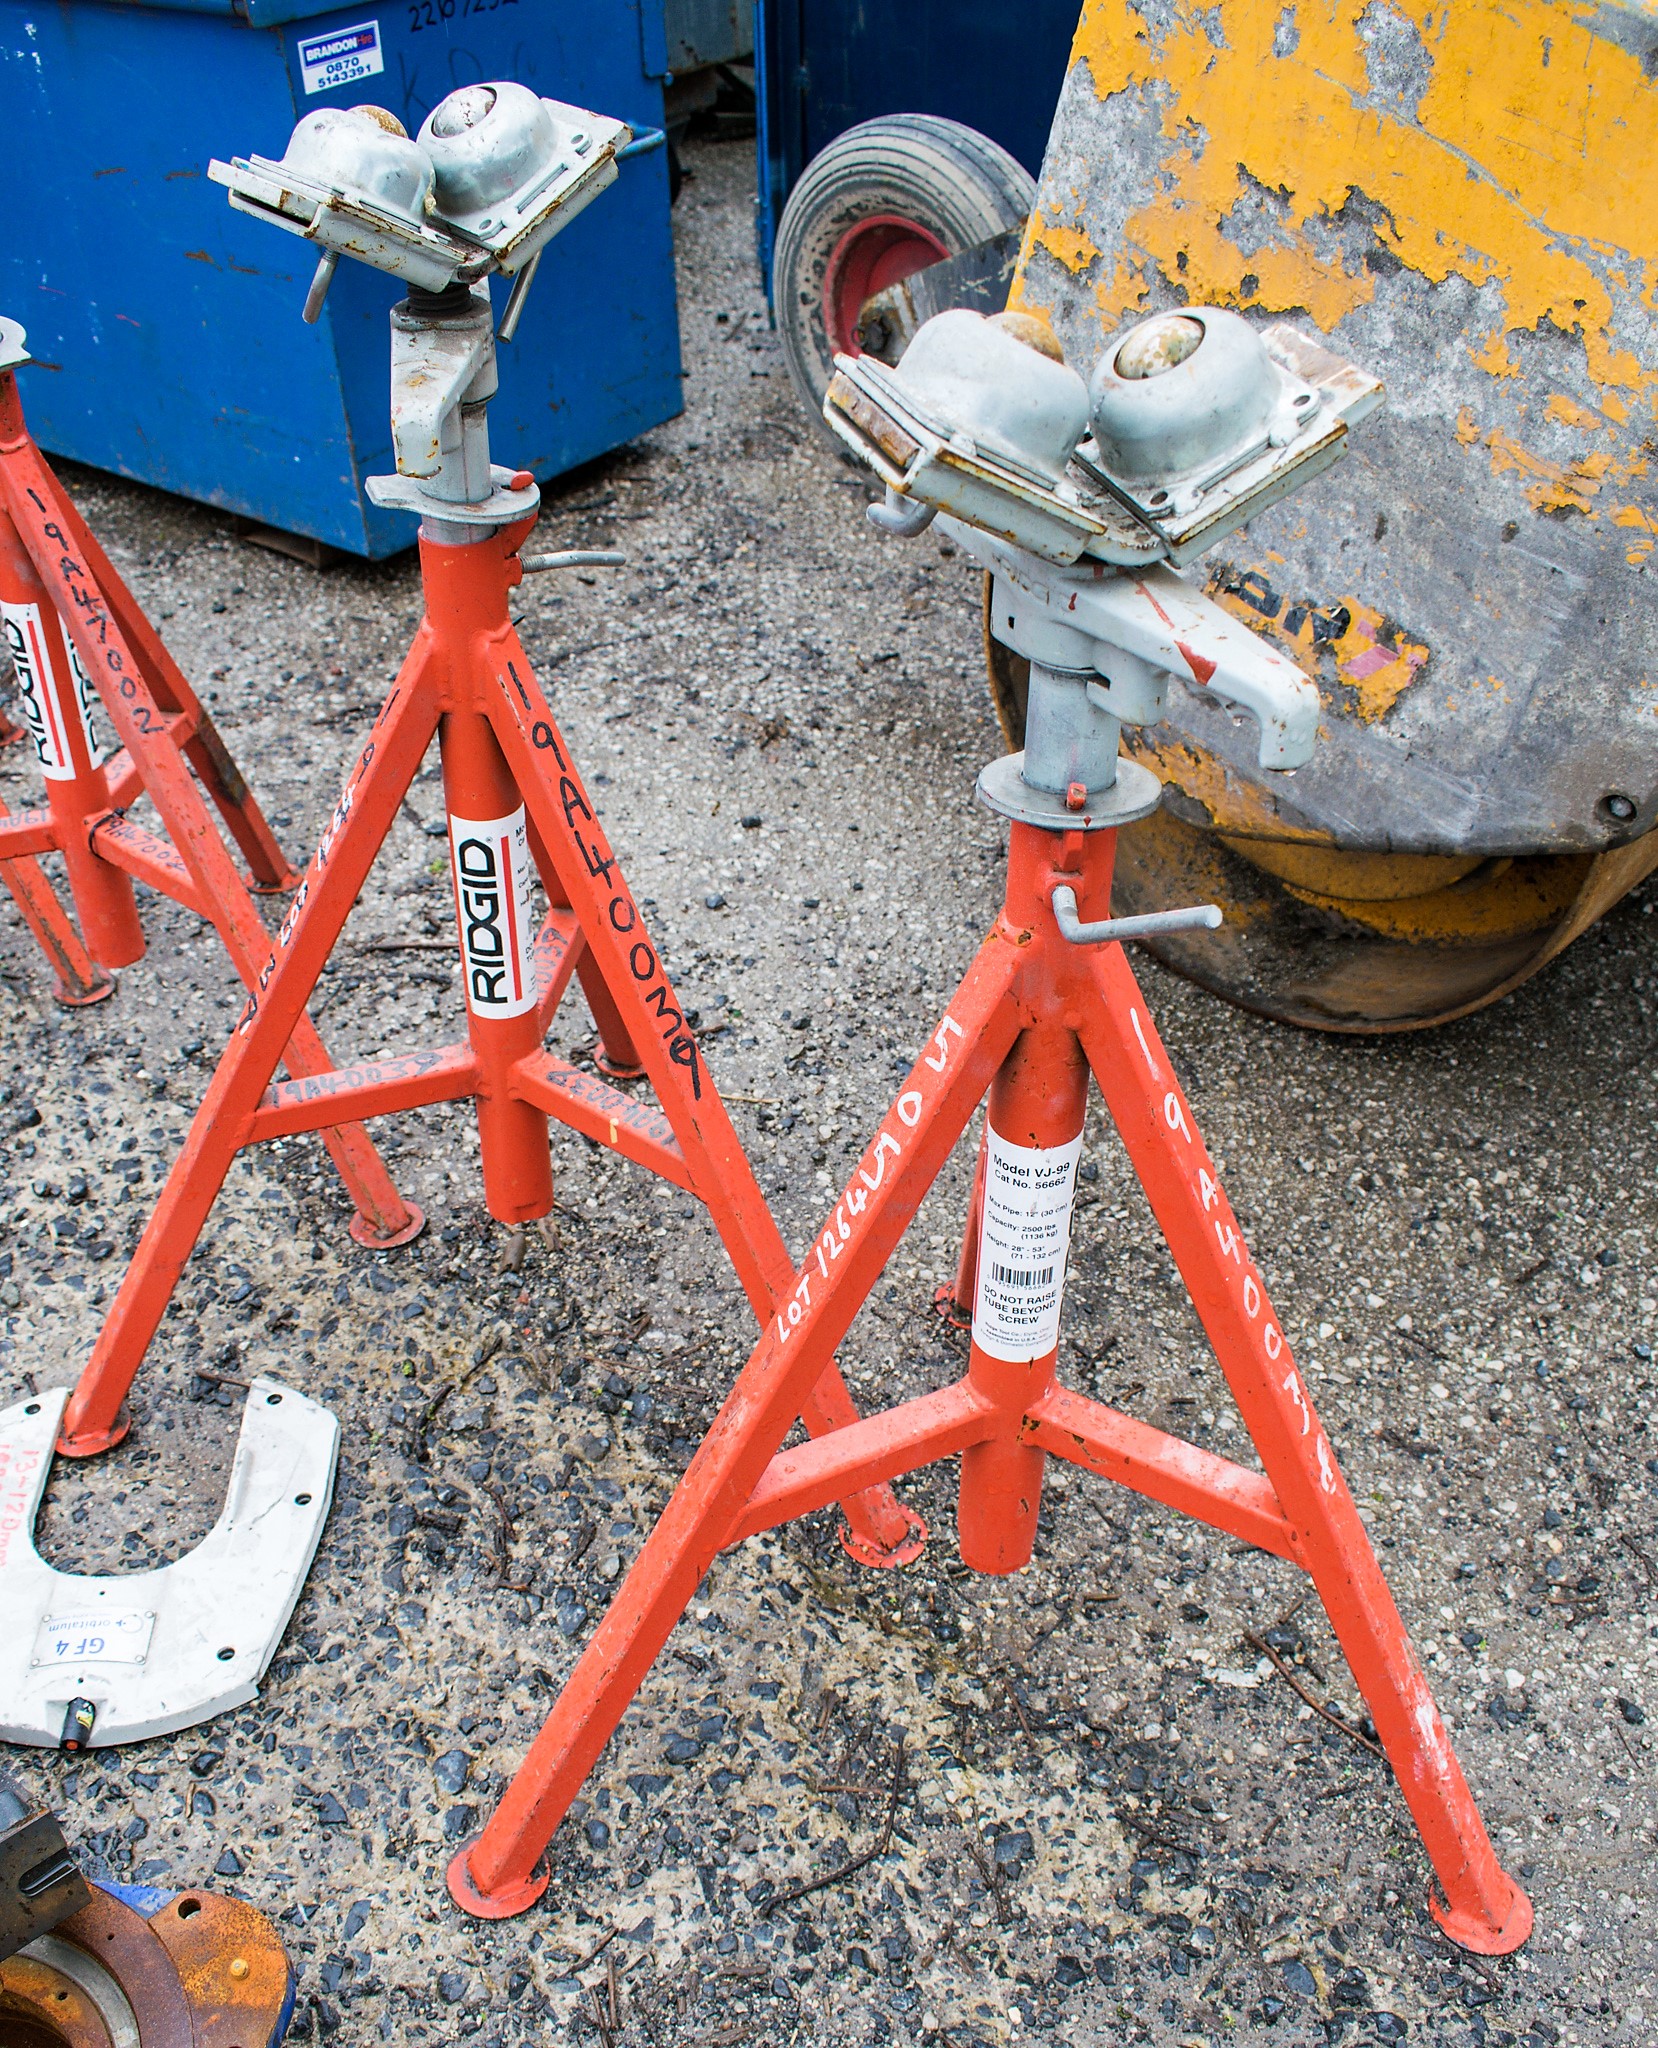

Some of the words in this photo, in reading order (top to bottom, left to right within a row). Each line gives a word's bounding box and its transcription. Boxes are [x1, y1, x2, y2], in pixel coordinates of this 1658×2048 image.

[305, 36, 358, 62] BRANDON
[317, 63, 372, 88] 5143391
[326, 56, 360, 74] 0870
[27, 488, 164, 734] 19A47002
[507, 661, 702, 1101] 19A40039
[458, 838, 509, 1004] RIDGID
[993, 1154, 1030, 1177] Model
[1034, 1162, 1071, 1178] VJ-99
[994, 1169, 1010, 1184] Cat
[1012, 1178, 1031, 1189] No.
[1034, 1176, 1067, 1190] 56662
[987, 1210, 1020, 1232] Capacity:
[1002, 1204, 1023, 1217] Pipe:
[1040, 1209, 1054, 1218] (30
[1010, 1252, 1023, 1260] (71
[1032, 1252, 1047, 1260] 132
[984, 1284, 997, 1298] DO
[999, 1293, 1024, 1305] NOT
[1026, 1289, 1057, 1305] RAISE
[984, 1293, 1009, 1313] TUBE
[1012, 1299, 1056, 1315] BEYOND
[776, 1273, 811, 1344] LOT
[997, 1313, 1040, 1325] SCREW
[48, 1619, 111, 1632] orbitalum
[55, 1640, 70, 1656] 4
[73, 1637, 105, 1655] GF
